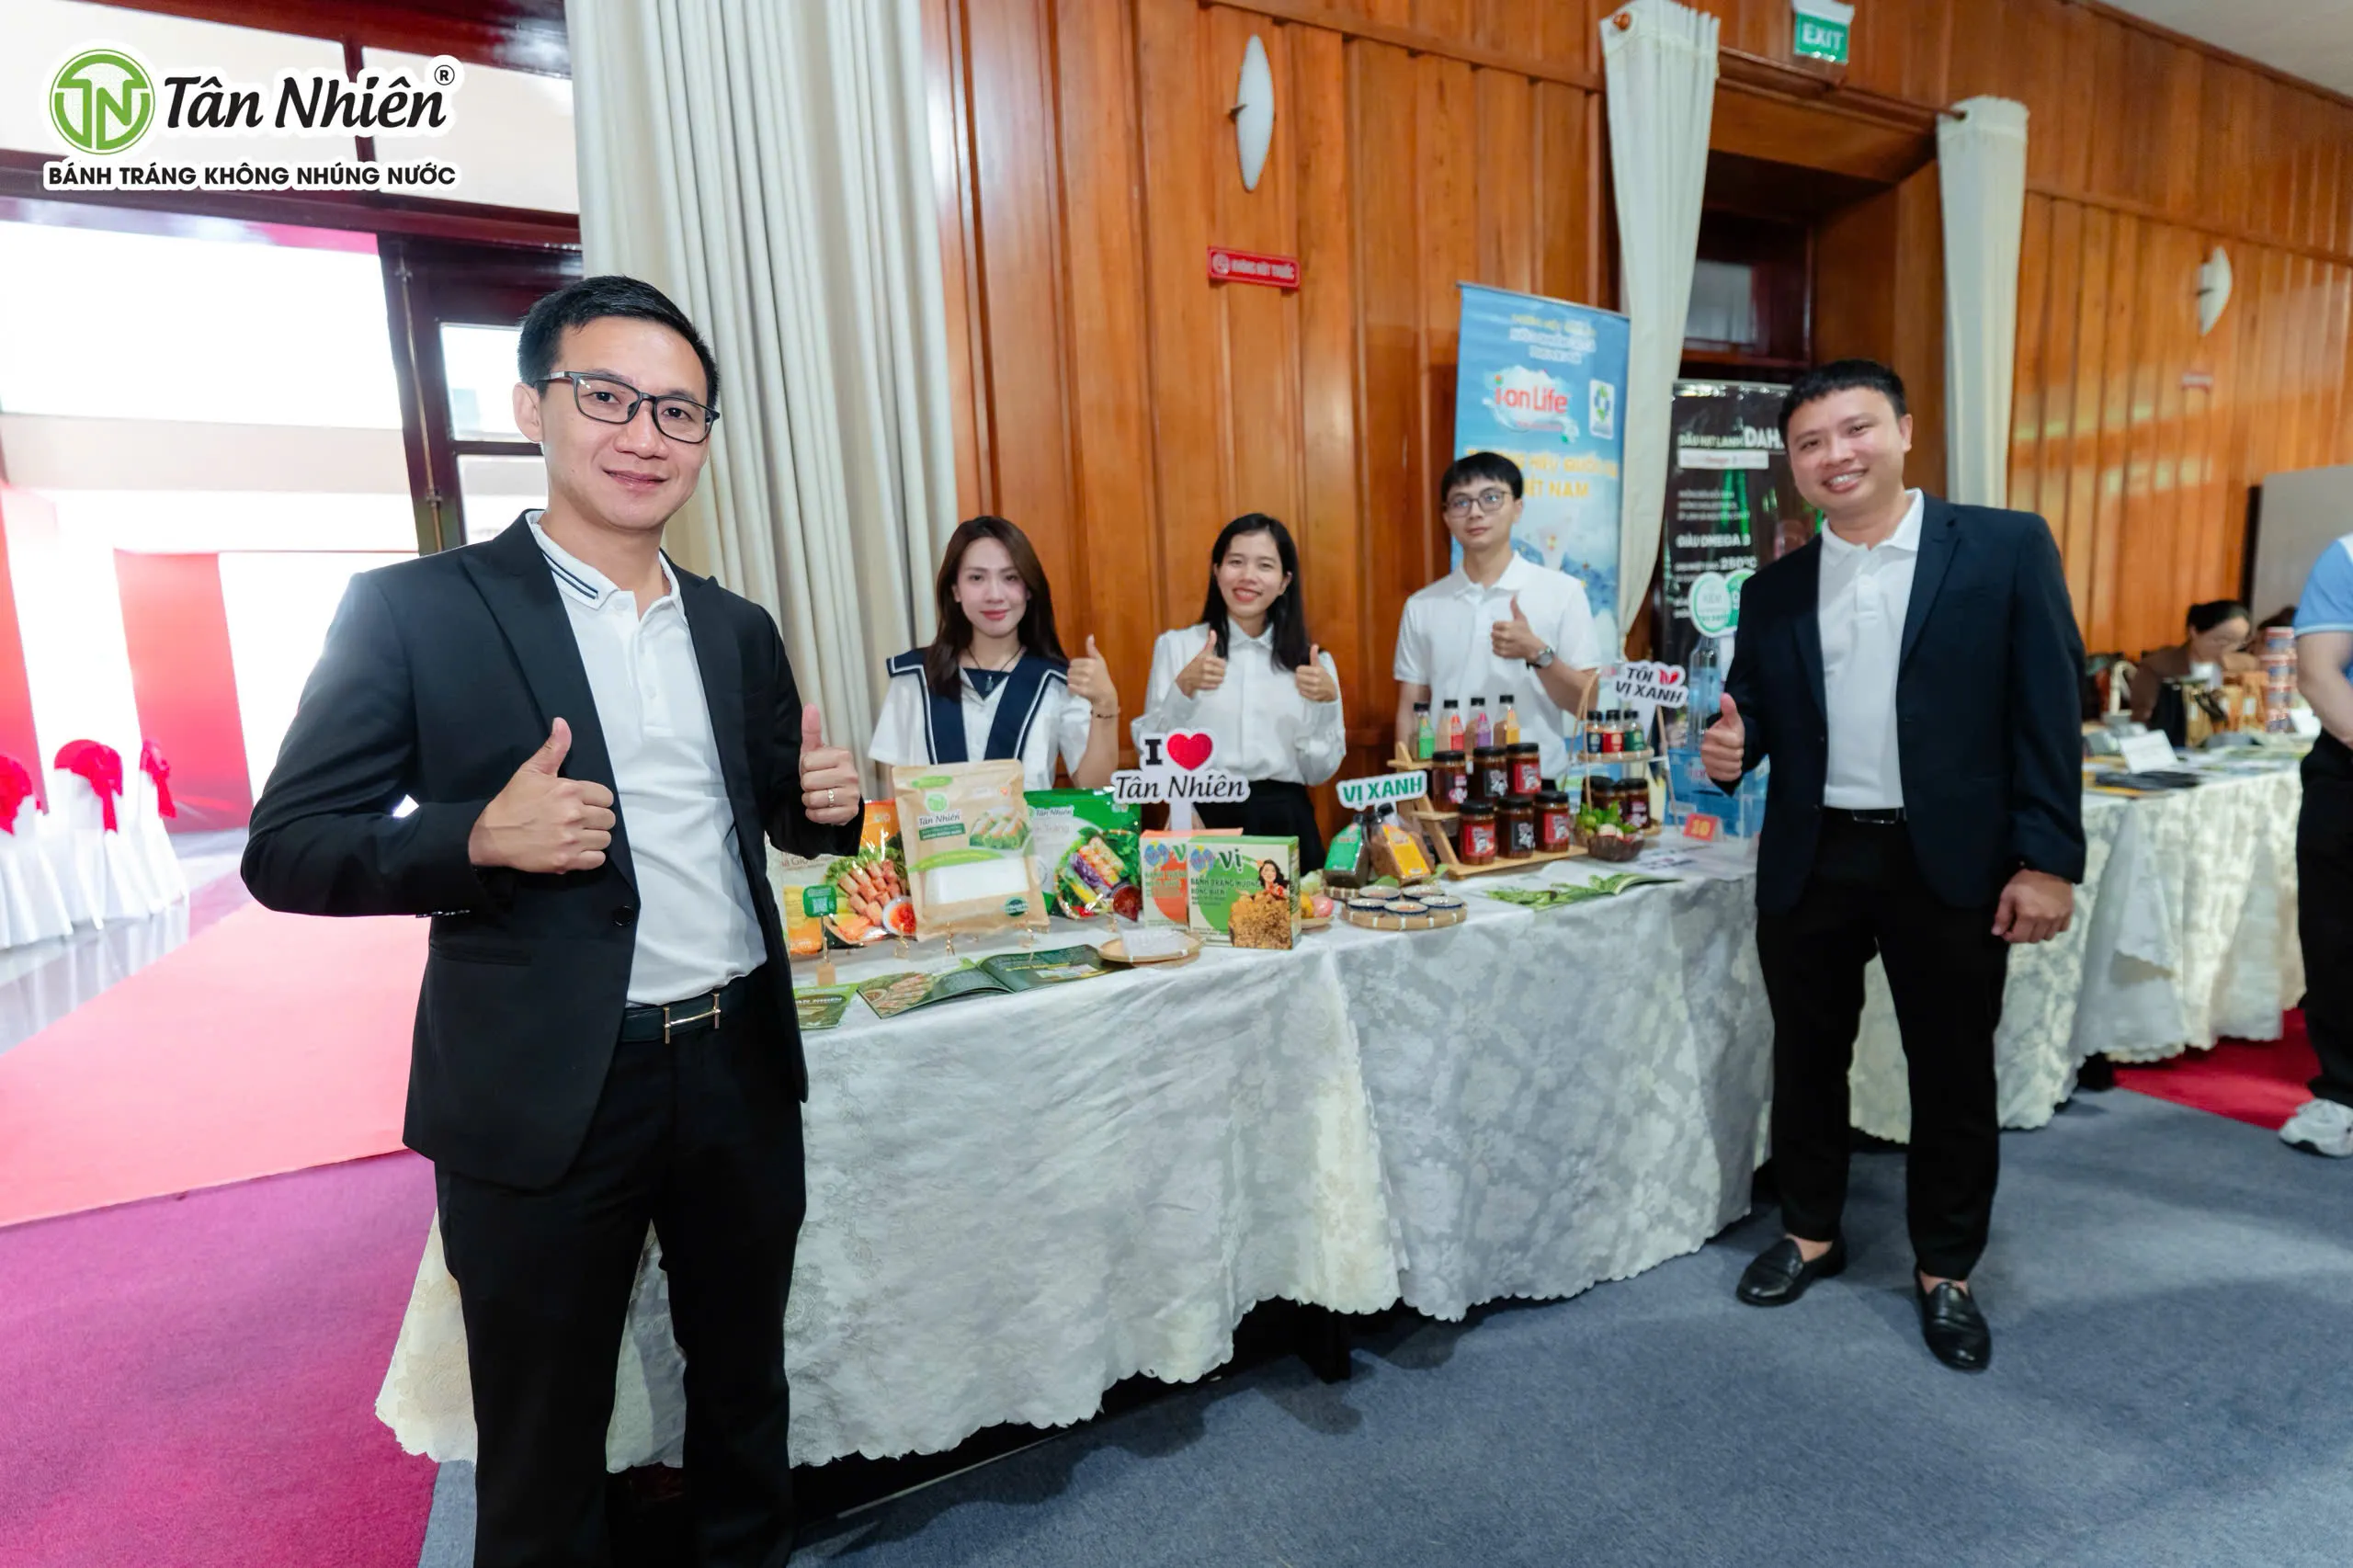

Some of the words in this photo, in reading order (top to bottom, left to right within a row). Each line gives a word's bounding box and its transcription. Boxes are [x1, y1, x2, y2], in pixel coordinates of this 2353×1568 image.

[1802, 21, 1844, 51] EXIT
[1743, 425, 1785, 449] DAH
[1627, 666, 1653, 683] TÔI
[1616, 681, 1630, 696] VỊ
[1632, 687, 1684, 703] XANH
[1145, 739, 1163, 765] I
[1116, 776, 1160, 799] Tân
[1168, 774, 1245, 798] Nhiên
[1343, 785, 1363, 807] VỊ
[1368, 775, 1423, 801] XANH
[1219, 848, 1242, 872] Vị
